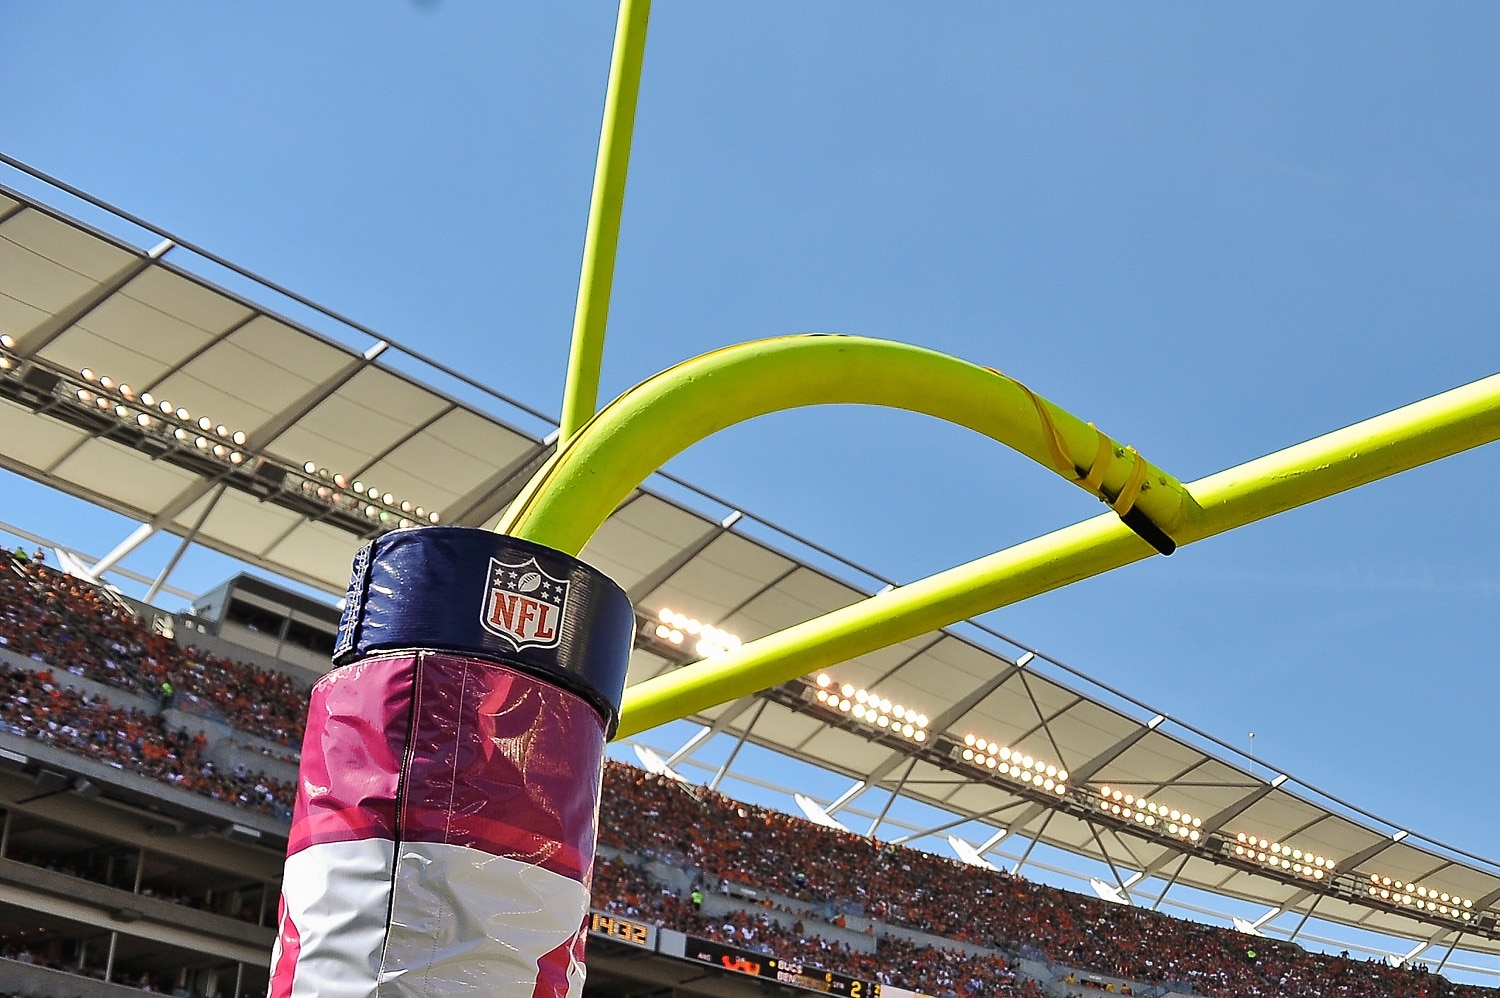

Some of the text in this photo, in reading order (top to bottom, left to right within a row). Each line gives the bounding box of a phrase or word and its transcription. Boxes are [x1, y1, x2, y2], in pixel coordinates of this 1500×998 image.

[491, 592, 555, 638] NFL
[592, 913, 648, 946] 14:32
[850, 981, 861, 998] 2
